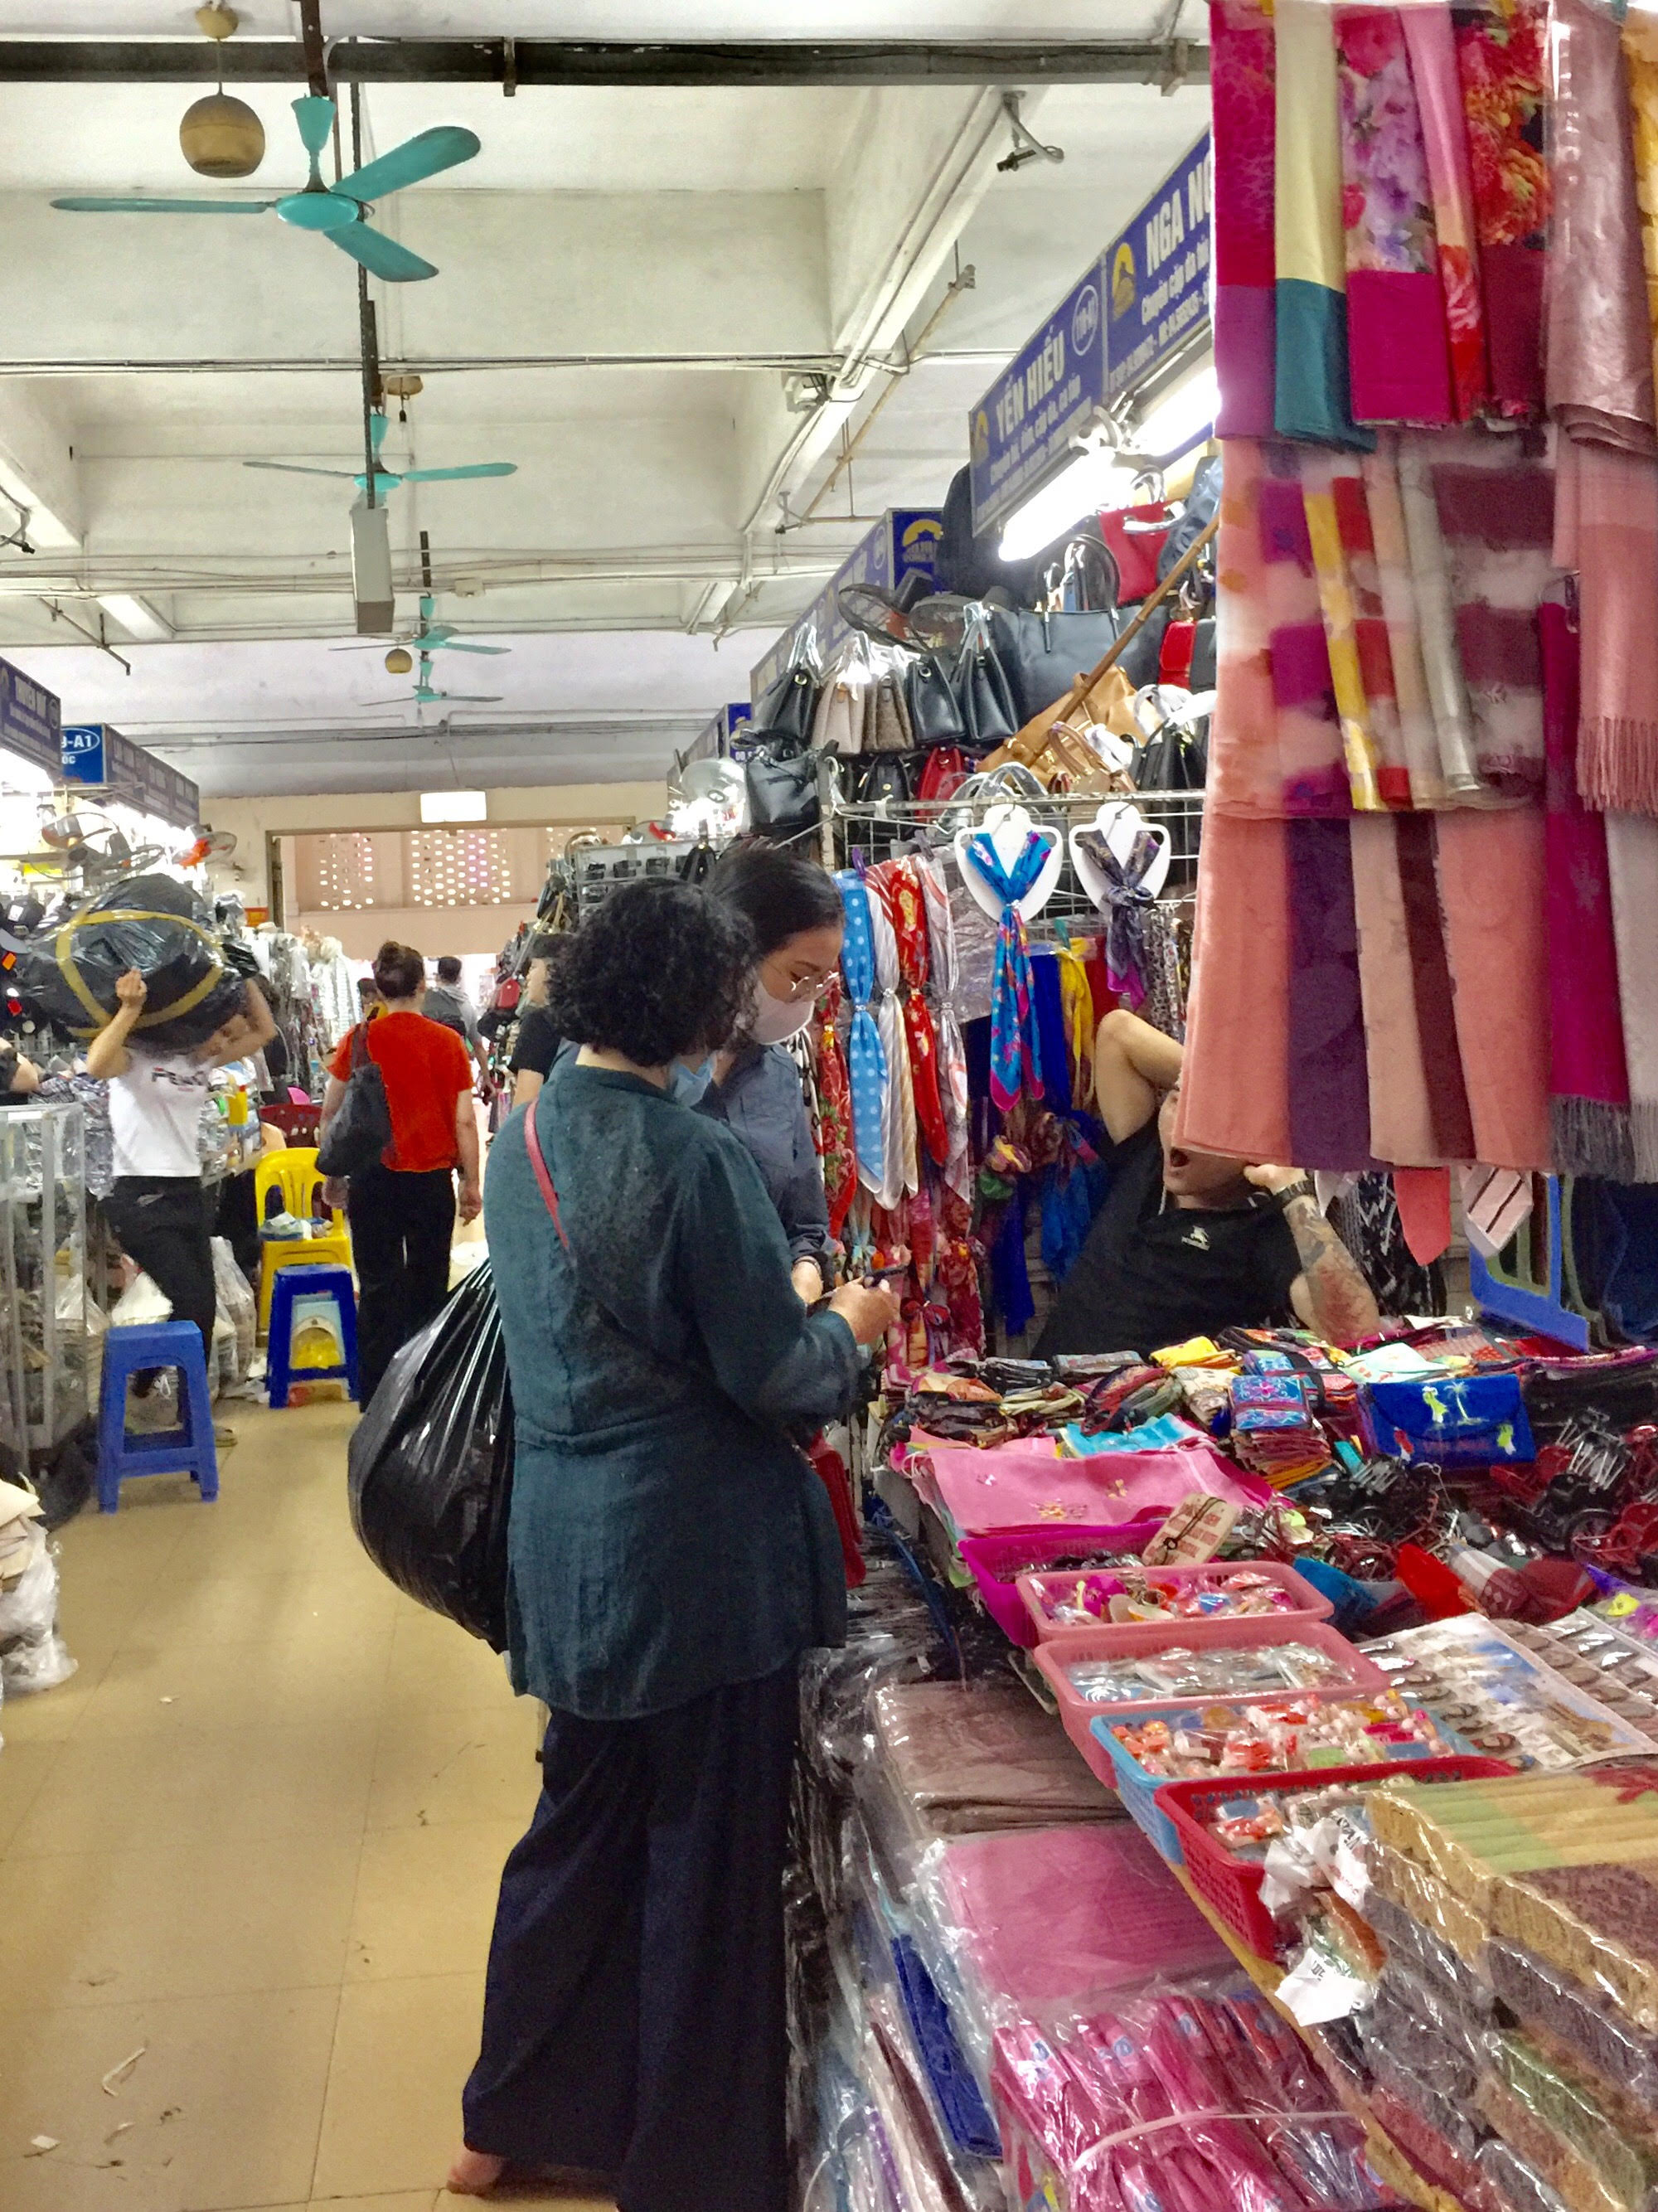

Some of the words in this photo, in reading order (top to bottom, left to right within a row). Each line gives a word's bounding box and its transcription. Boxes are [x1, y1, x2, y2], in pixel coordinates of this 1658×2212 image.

[1147, 188, 1185, 278] NGA
[996, 374, 1025, 444] YẾN
[1026, 324, 1065, 411] HIẾU
